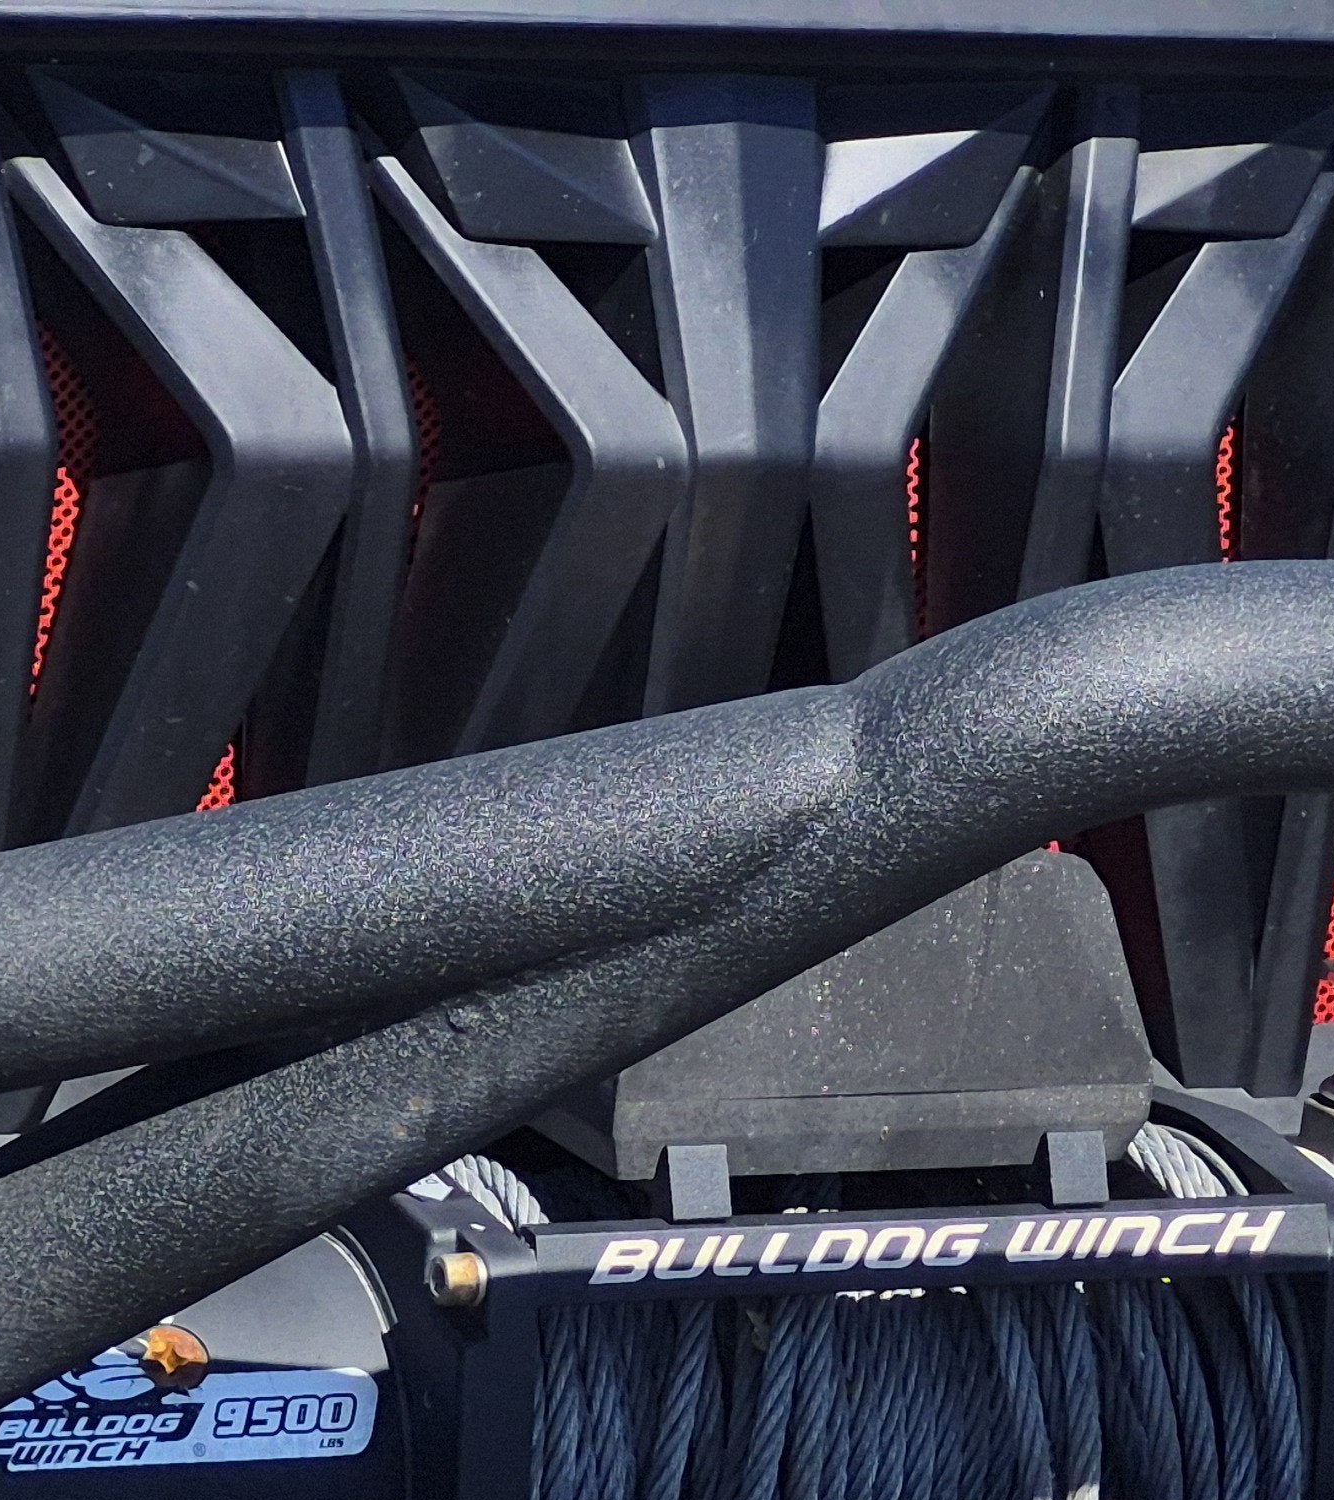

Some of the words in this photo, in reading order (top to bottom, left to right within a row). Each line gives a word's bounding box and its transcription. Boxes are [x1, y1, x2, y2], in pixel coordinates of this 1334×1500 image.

[587, 1222, 989, 1285] BULLDOG
[1005, 1210, 1286, 1264] WINCH
[213, 1393, 357, 1438] 9500
[12, 1437, 149, 1465] WINCH
[319, 1437, 345, 1449] LBS
